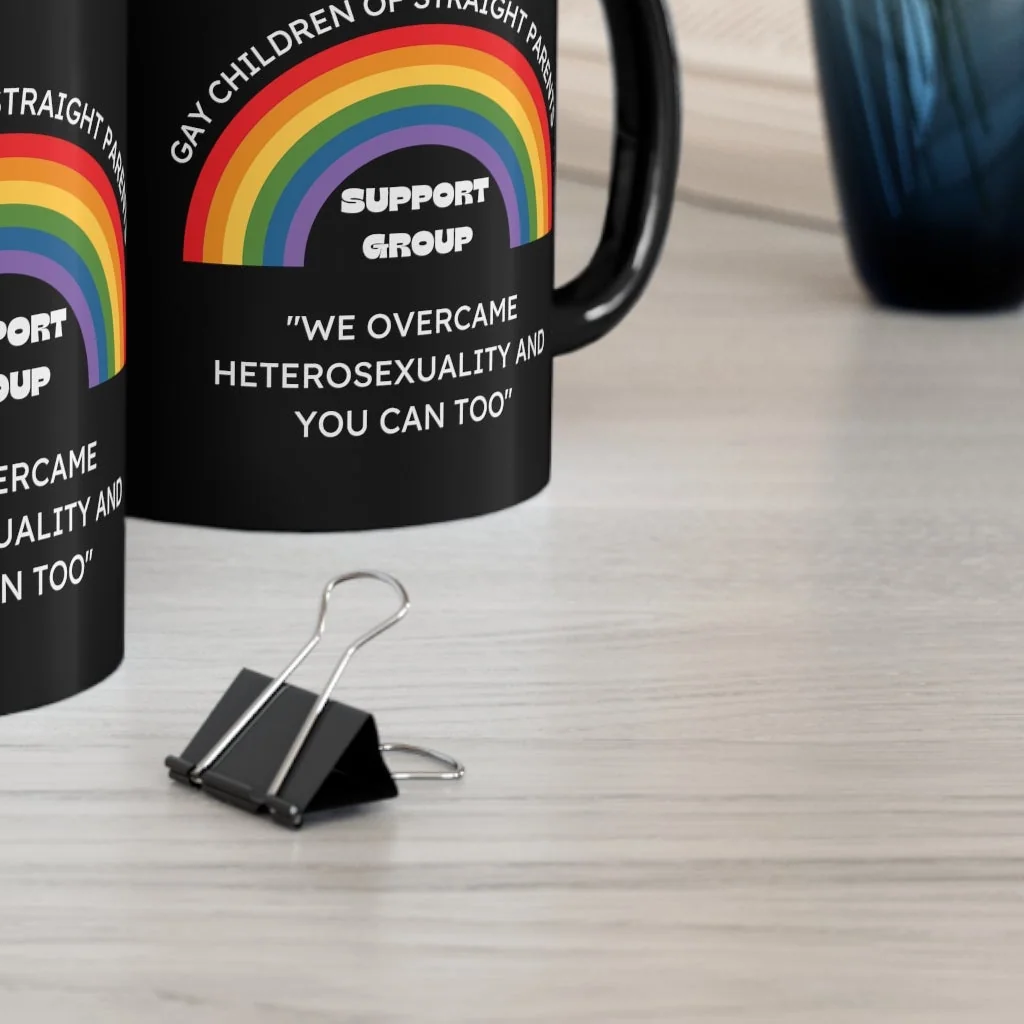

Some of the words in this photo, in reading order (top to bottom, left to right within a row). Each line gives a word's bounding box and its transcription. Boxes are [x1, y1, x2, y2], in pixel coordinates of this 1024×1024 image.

[171, 101, 212, 163] GAY
[209, 0, 355, 103] CHILDREN
[341, 177, 489, 213] SUPPORT
[363, 226, 473, 259] GROUP
[368, 294, 517, 339] OVERCAME
[215, 338, 511, 388] HETEROSEXUALITY
[516, 329, 545, 364] AND
[295, 410, 367, 437] YOU
[380, 398, 444, 434] CAN
[95, 477, 123, 521] AND
